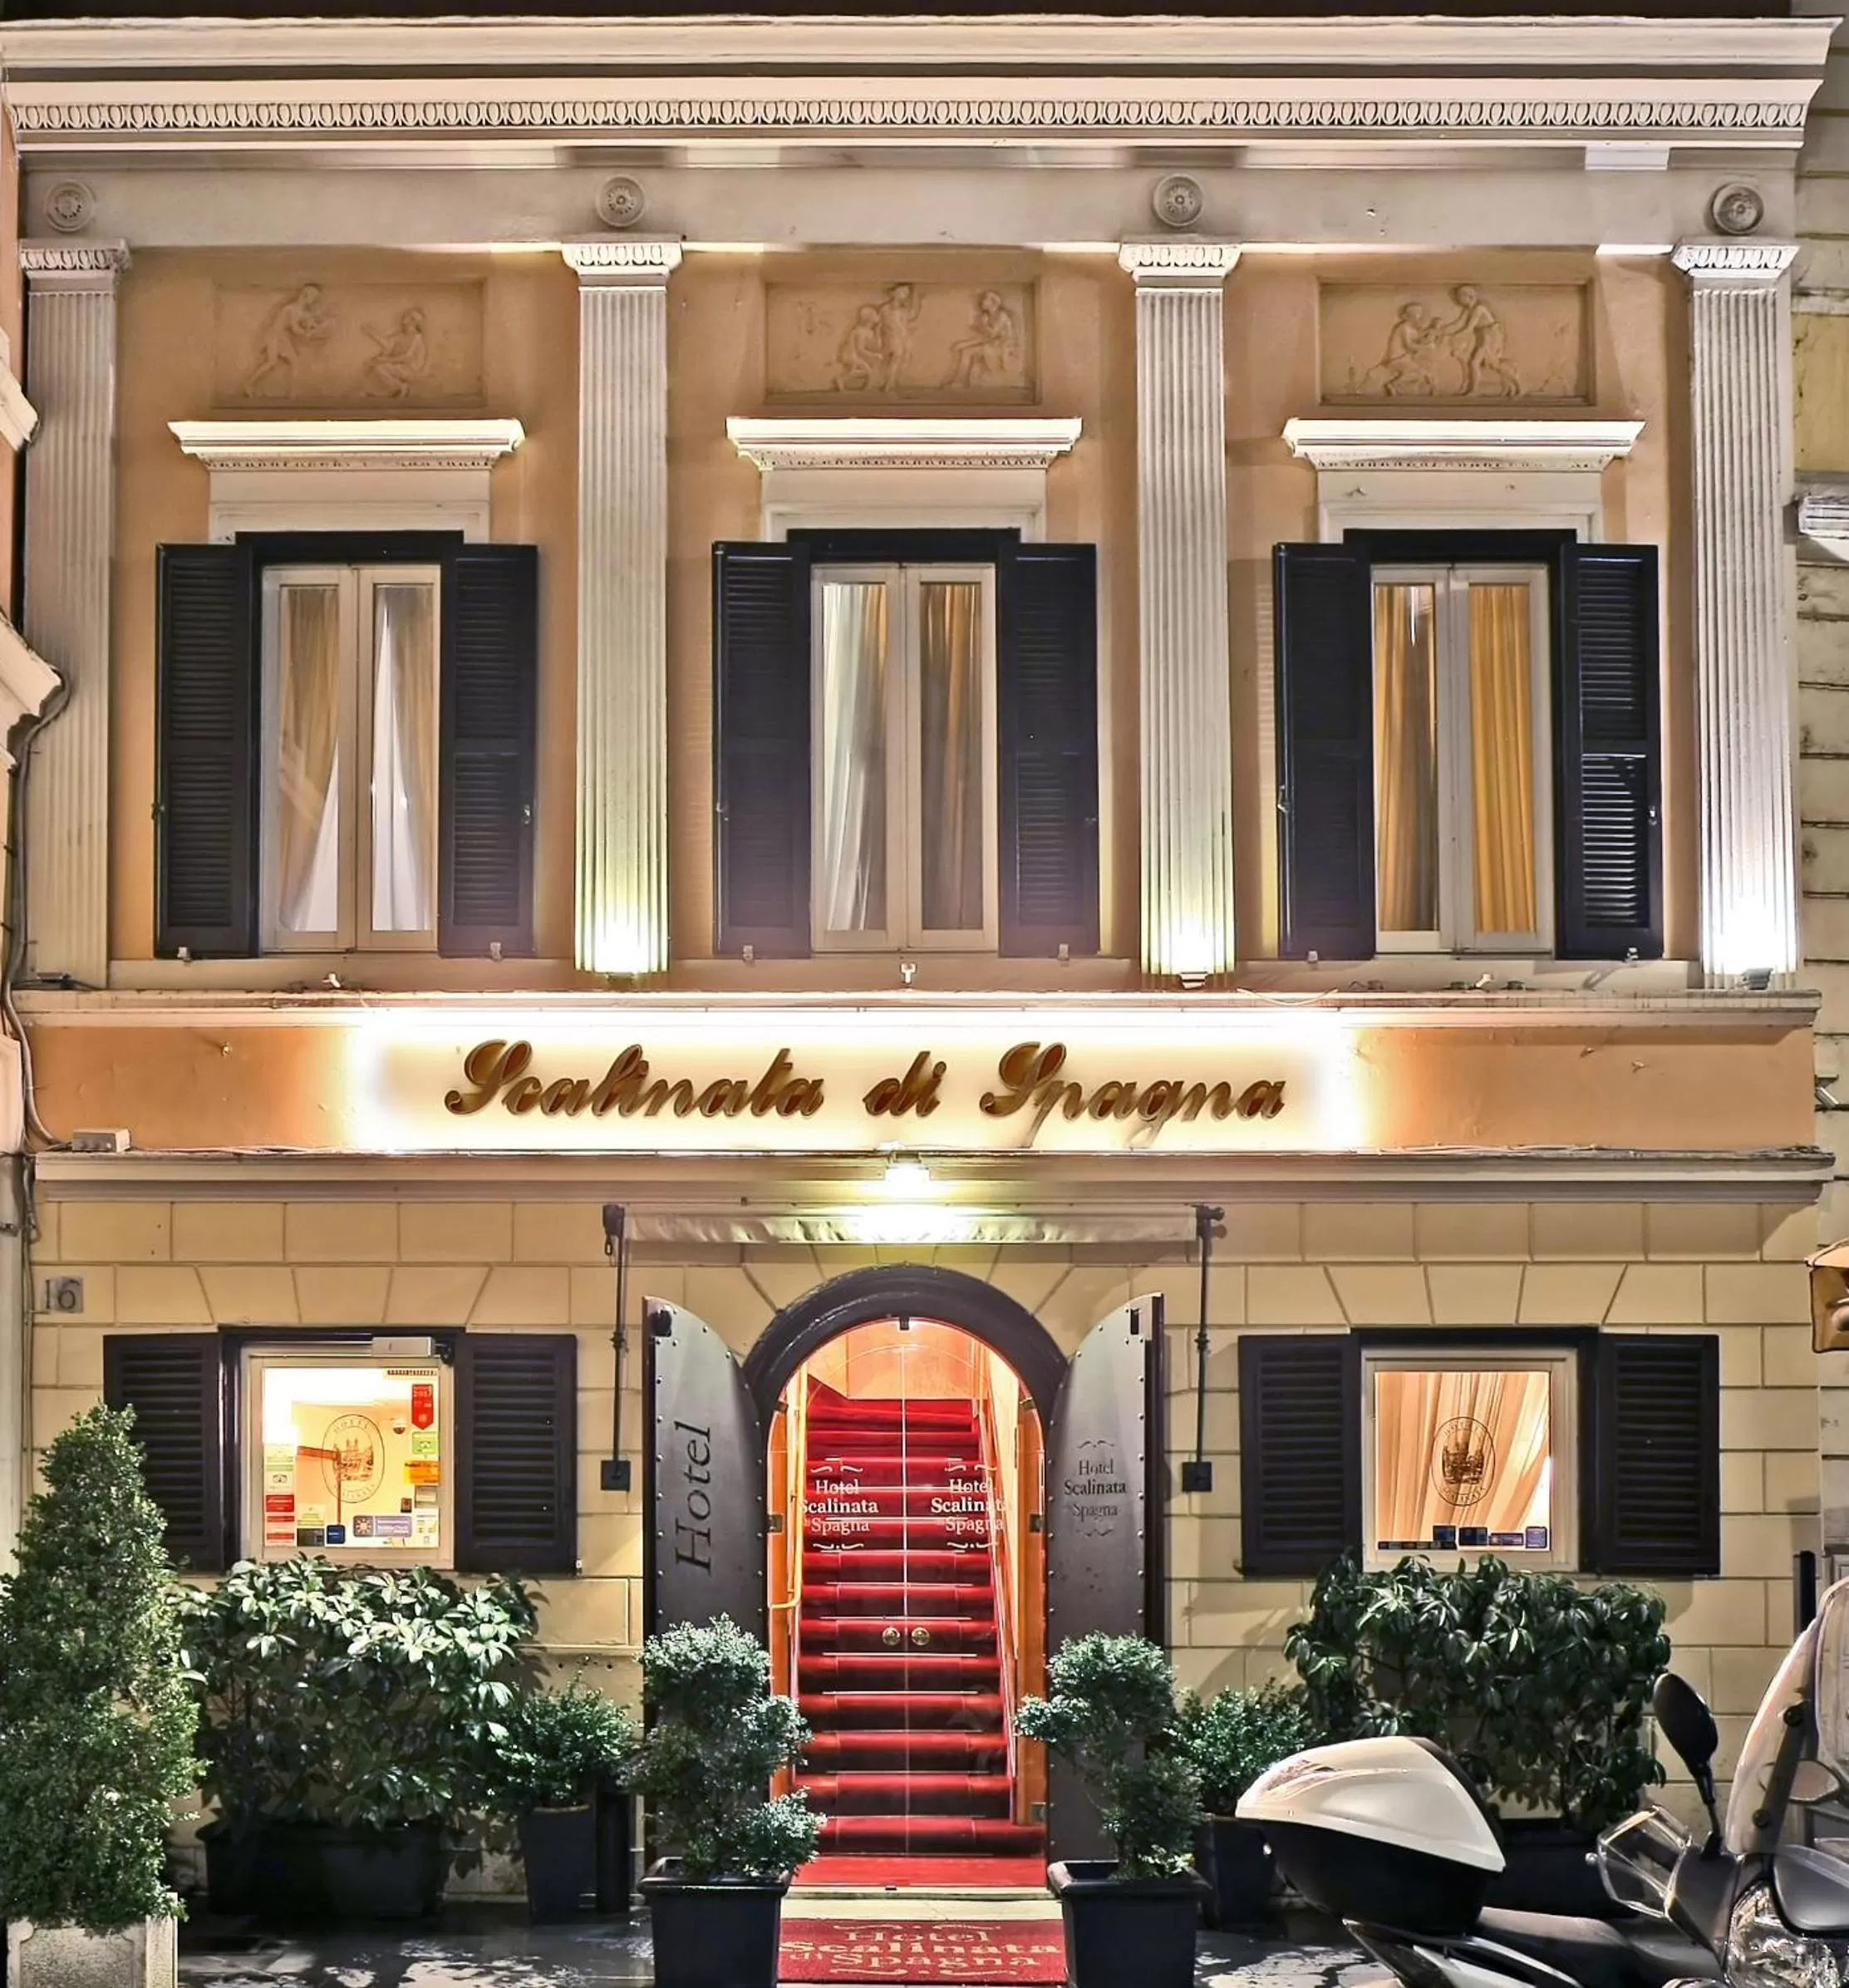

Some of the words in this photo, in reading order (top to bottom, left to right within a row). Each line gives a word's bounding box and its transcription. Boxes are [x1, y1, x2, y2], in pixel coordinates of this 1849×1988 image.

[445, 1039, 824, 1116] Scalinata
[863, 1051, 947, 1116] di
[980, 1041, 1286, 1148] Spagna
[46, 1278, 81, 1309] 16
[1079, 1458, 1114, 1475] Hotel
[815, 1479, 859, 1494] Hotel
[1064, 1479, 1127, 1496] Scalinata
[674, 1420, 711, 1577] Hotel
[799, 1498, 878, 1513] Scalinata
[1071, 1503, 1119, 1523] Spagna
[810, 1517, 870, 1536] Spagna
[844, 1931, 989, 1942] Hotel
[779, 1941, 1062, 1953] Scalinata
[831, 1953, 1041, 1968] Spagna
